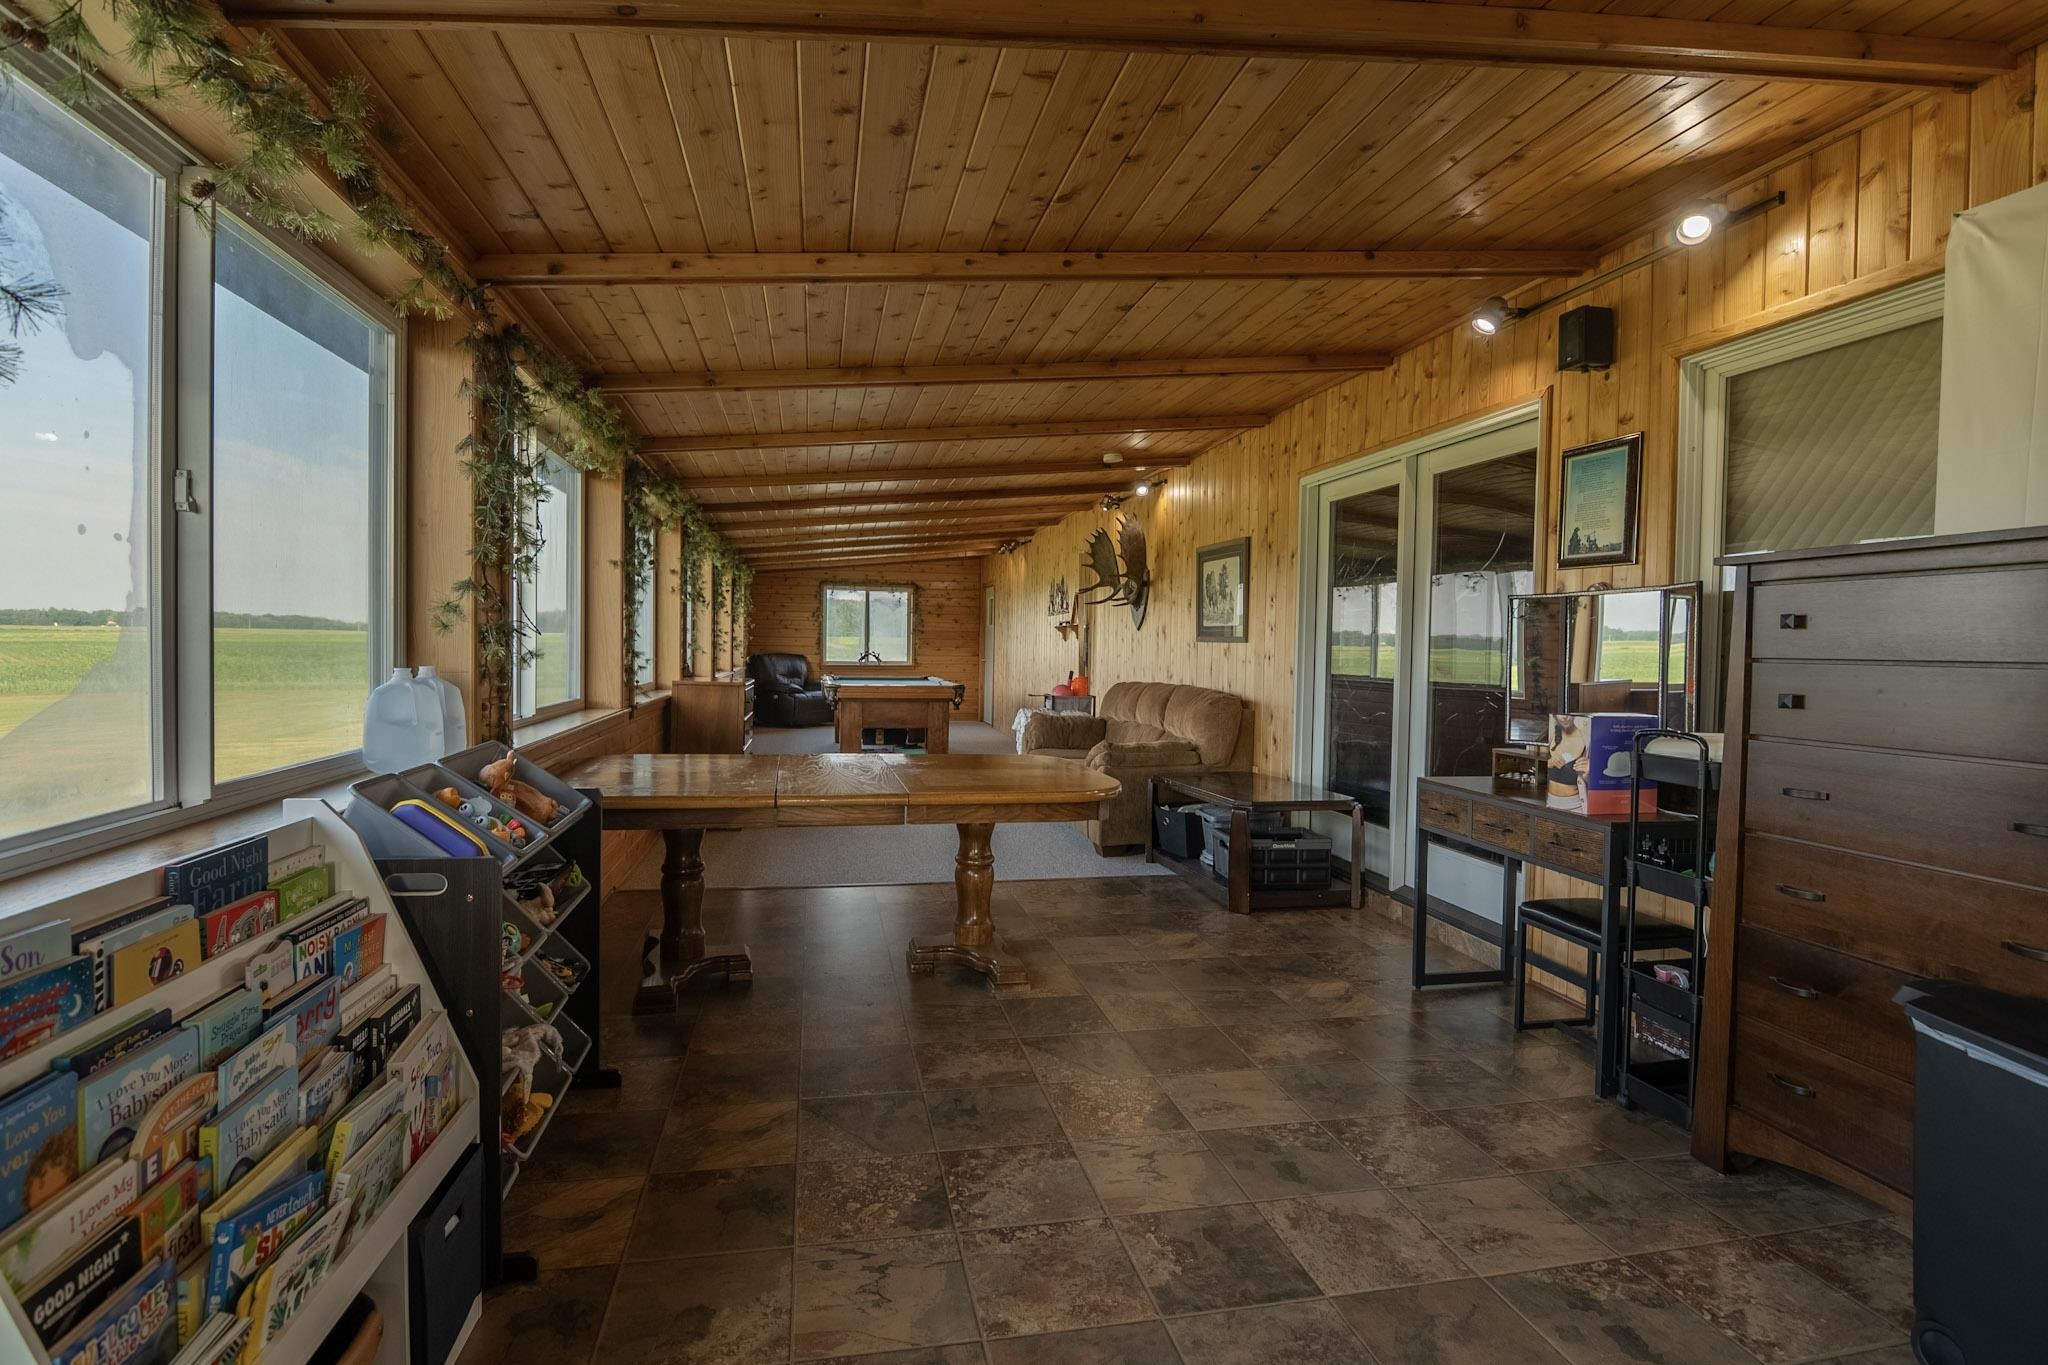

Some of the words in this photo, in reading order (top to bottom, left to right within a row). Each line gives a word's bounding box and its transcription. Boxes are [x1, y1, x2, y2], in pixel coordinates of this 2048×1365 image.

[190, 855, 226, 888] Good
[231, 847, 264, 871] Night
[191, 871, 263, 917] Farm
[1, 944, 46, 975] Son
[298, 930, 332, 961] NOISY
[107, 1081, 137, 1106] Love
[139, 1071, 161, 1088] You
[109, 1070, 187, 1129] Babysaur
[5, 1121, 40, 1150] Love
[42, 1105, 67, 1127] You
[235, 1112, 255, 1137] Love
[256, 1103, 272, 1121] You
[235, 1103, 288, 1160] Babysaur
[1, 1148, 32, 1178] ver
[79, 1193, 111, 1227] Love
[113, 1175, 134, 1199] My
[33, 1281, 75, 1325] GOOD
[70, 1279, 169, 1365] WELCOME
